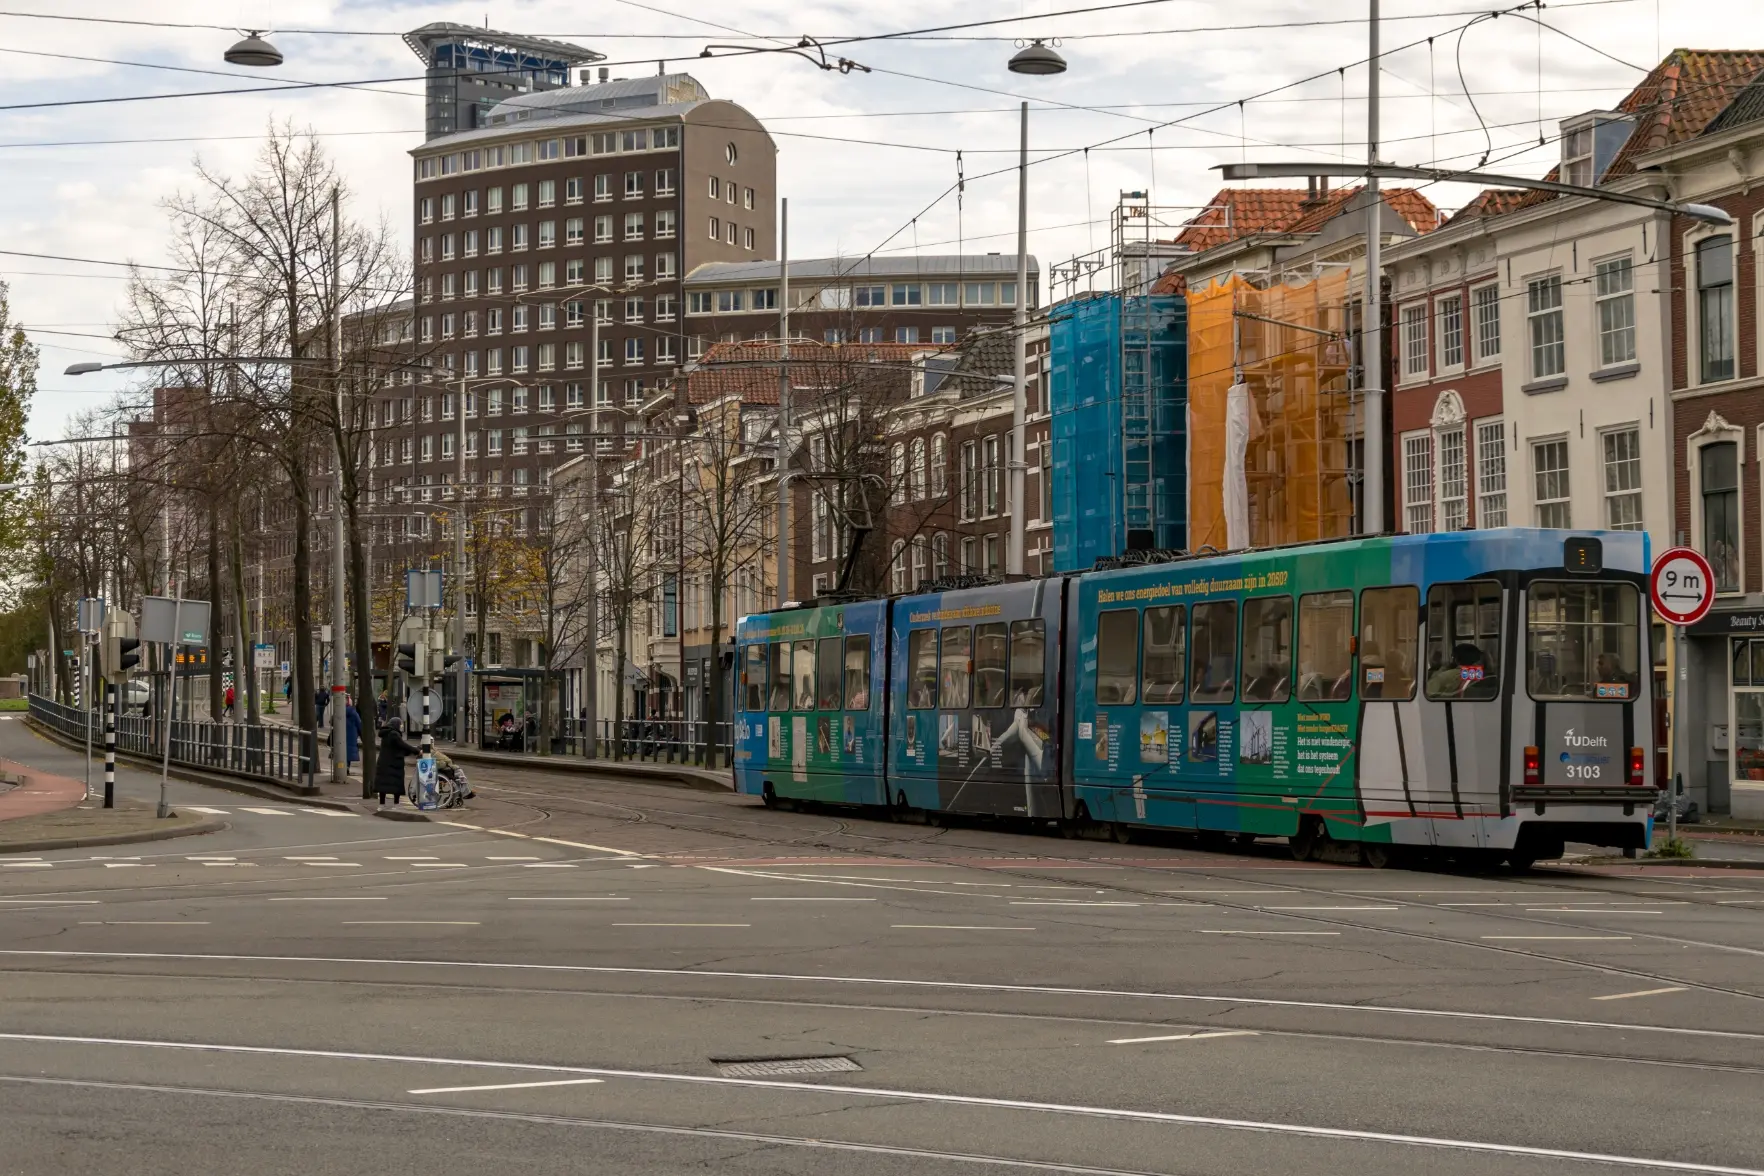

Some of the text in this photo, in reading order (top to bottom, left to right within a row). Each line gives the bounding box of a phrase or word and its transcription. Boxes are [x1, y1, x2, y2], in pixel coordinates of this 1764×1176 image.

[1171, 584, 1183, 596] van
[1184, 579, 1209, 596] volledig
[1210, 577, 1242, 592] duurzaam
[1244, 573, 1257, 592] zijn
[1258, 572, 1266, 588] in
[1267, 571, 1288, 587] 2050?
[1665, 570, 1700, 589] 9 m
[1730, 615, 1757, 629] Beauty
[1319, 752, 1338, 762] systeem
[1566, 765, 1600, 778] 3103
